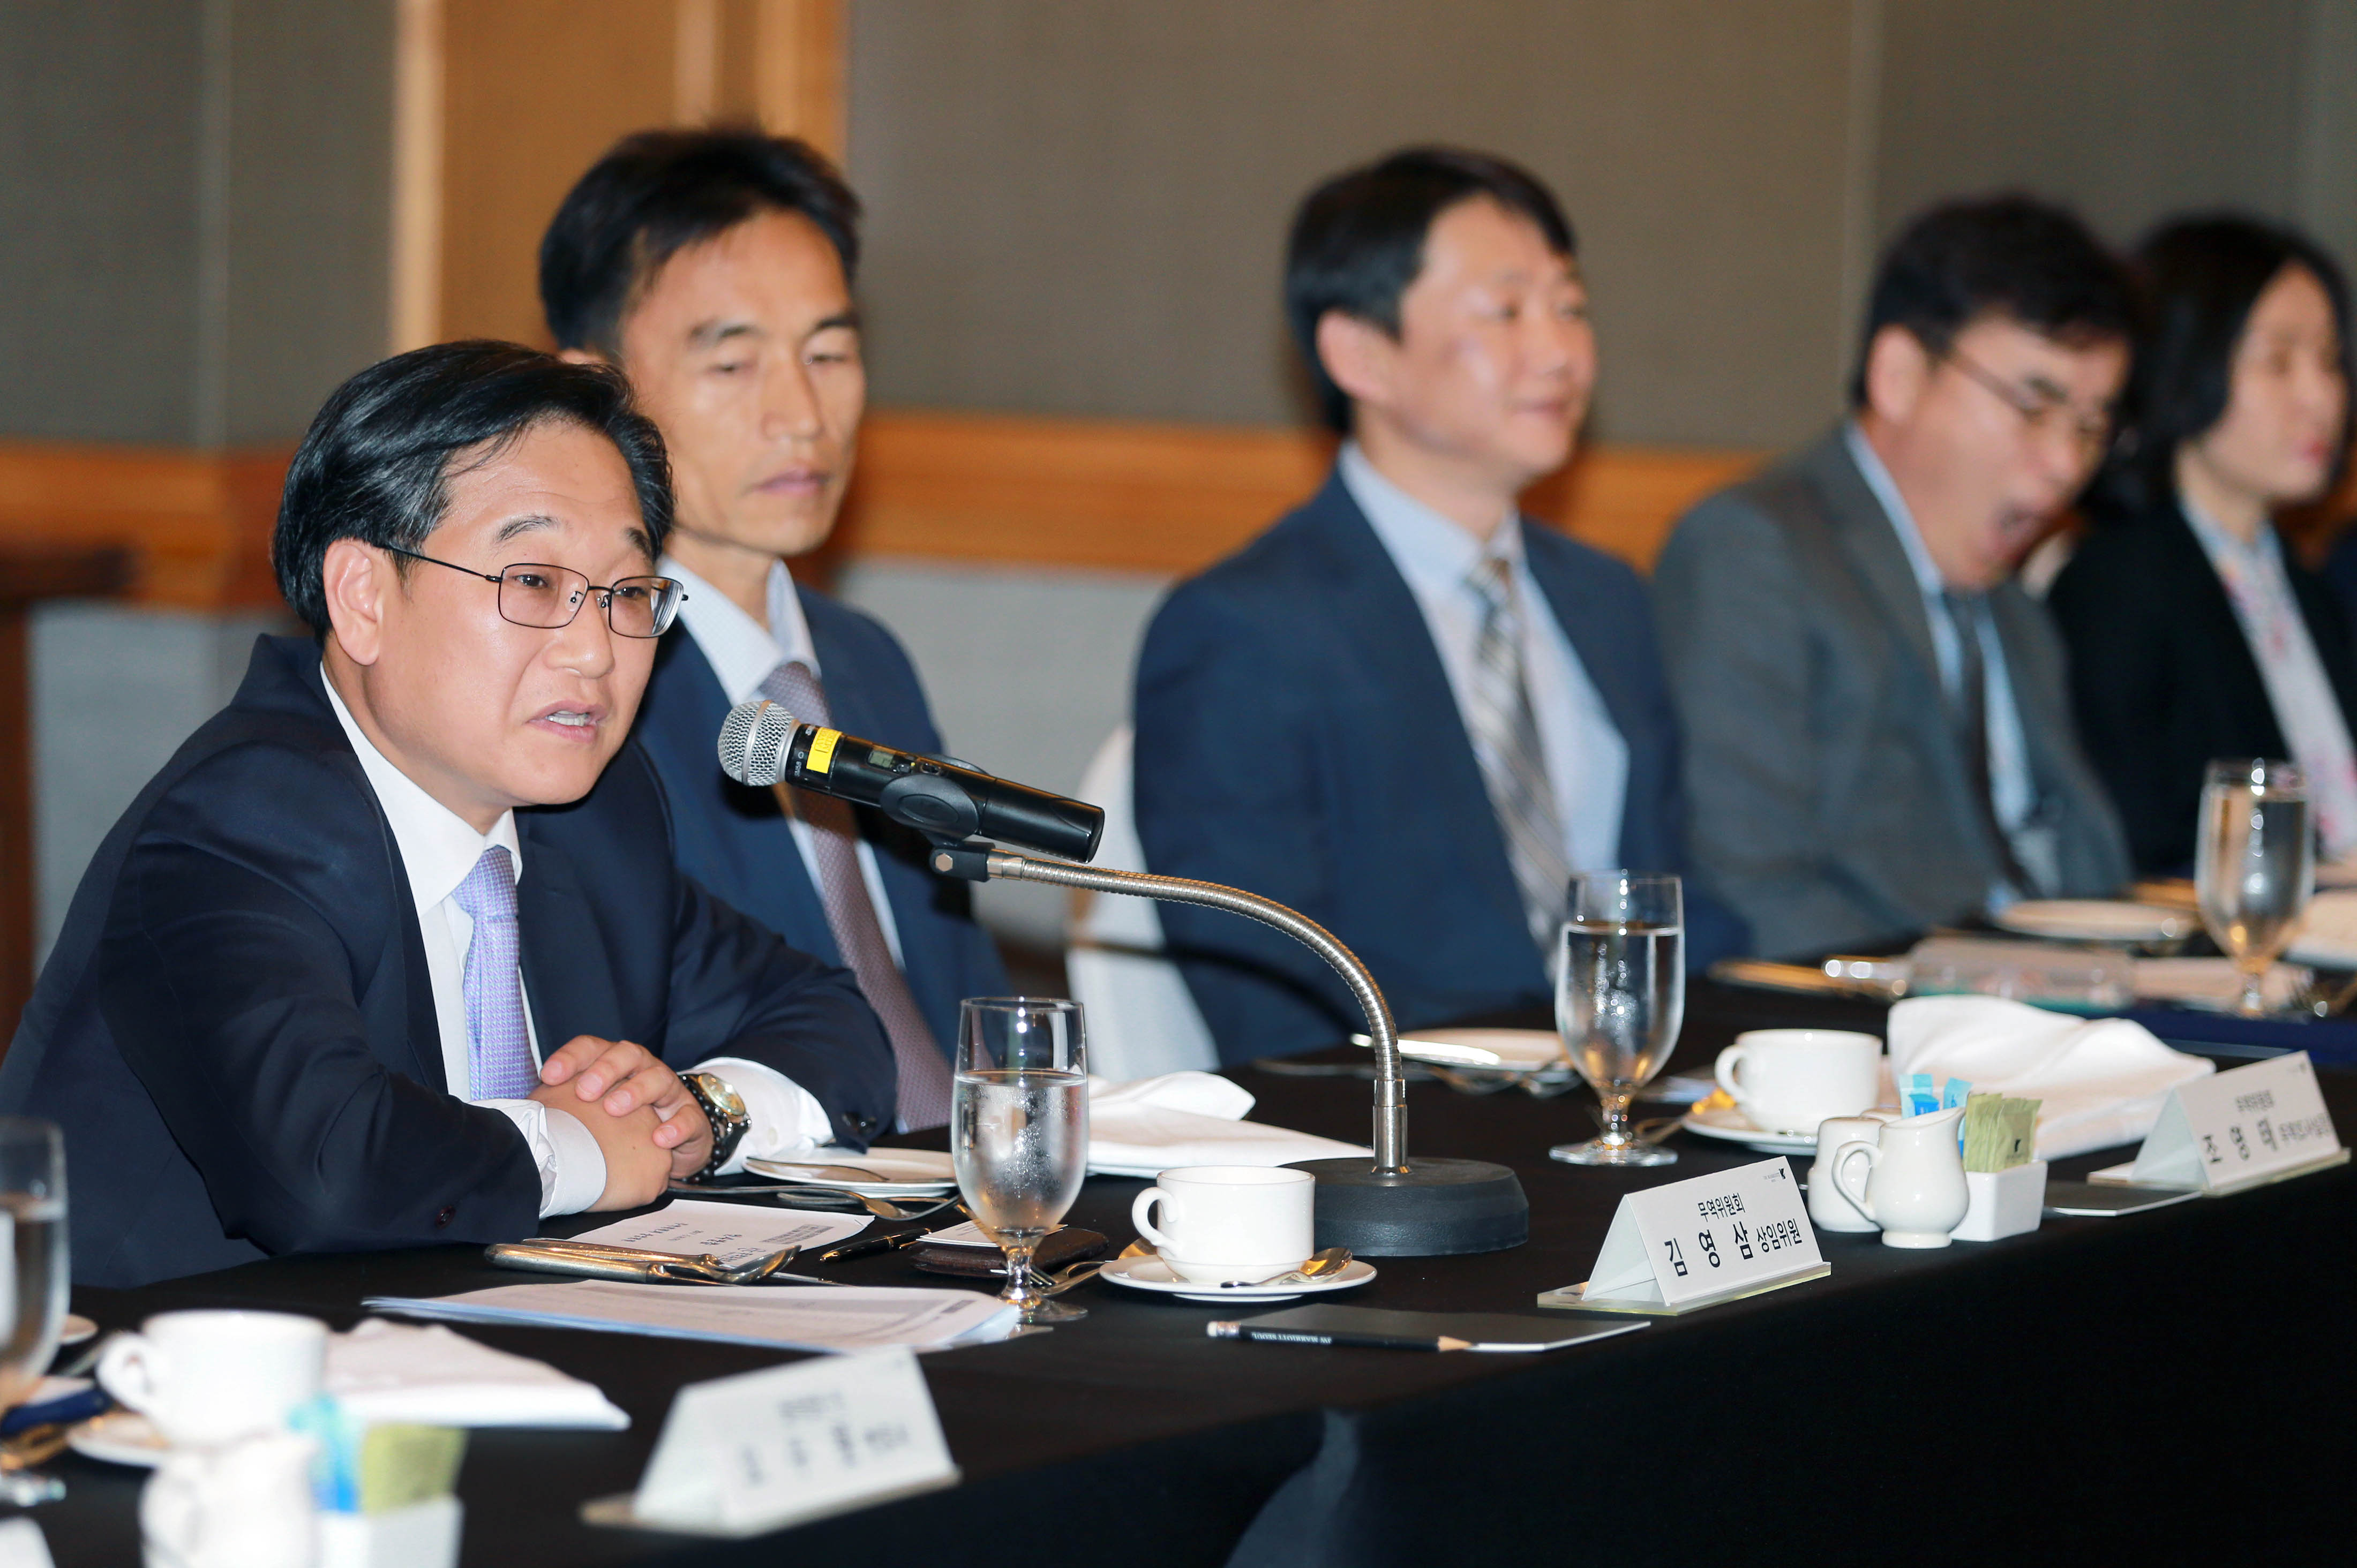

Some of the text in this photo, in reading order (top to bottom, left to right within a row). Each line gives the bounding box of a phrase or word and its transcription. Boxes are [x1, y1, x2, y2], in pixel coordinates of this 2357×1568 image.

[1698, 1192, 1745, 1222] 무역위원회
[1664, 1218, 1802, 1277] 김 영 삼 상임위원
[1251, 1332, 1277, 1340] SEOUL
[1278, 1334, 1318, 1343] MARRIOTT
